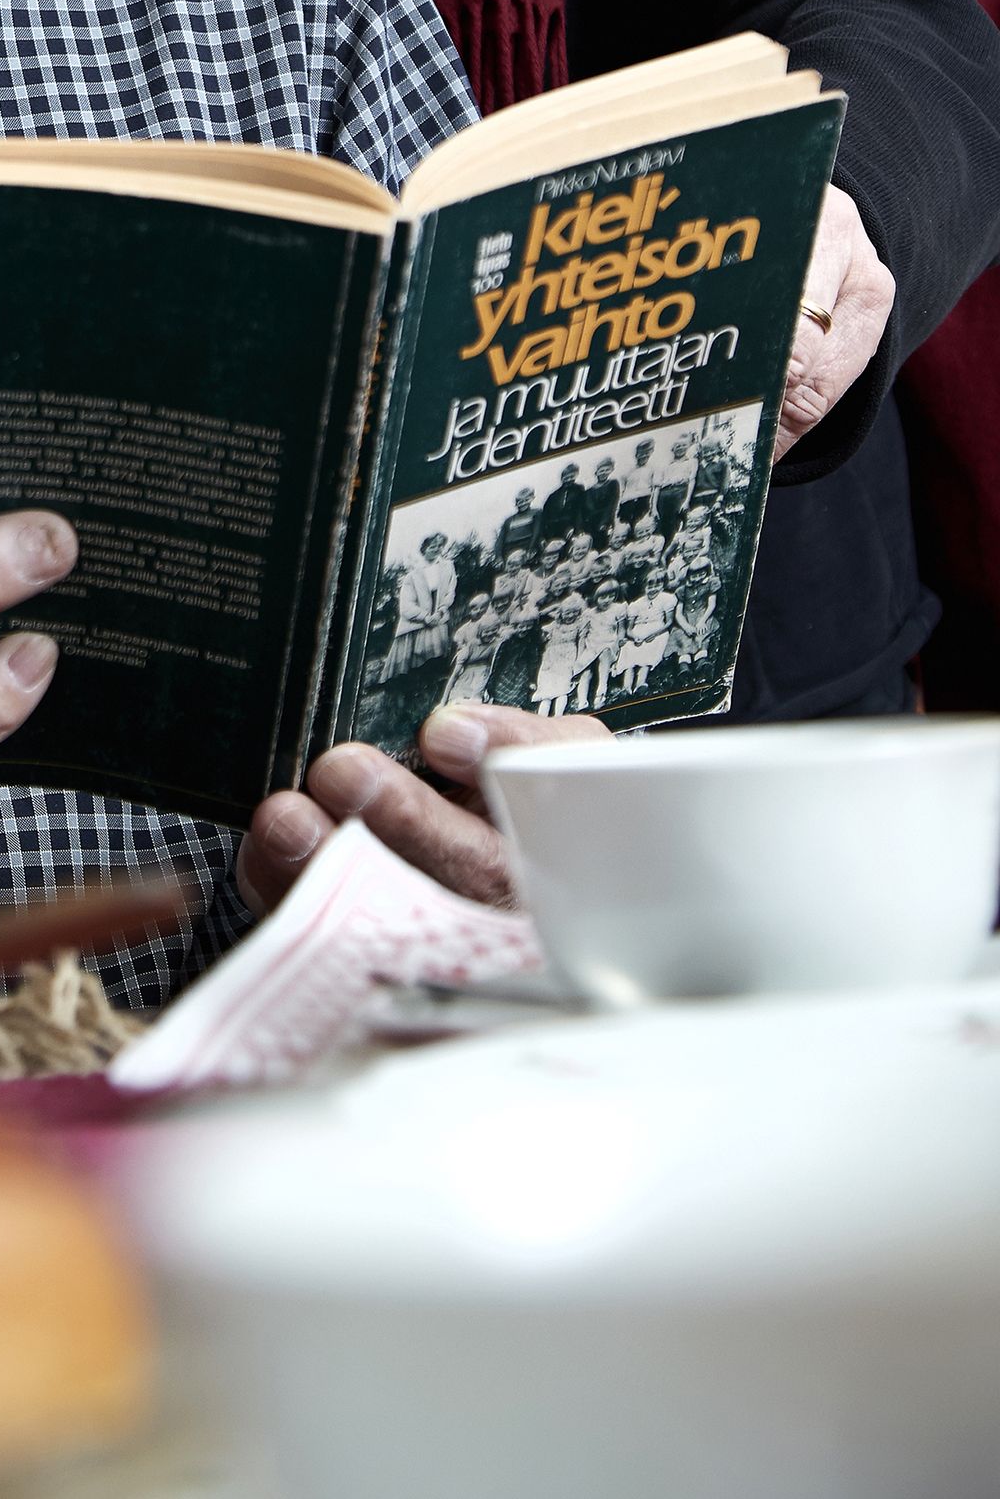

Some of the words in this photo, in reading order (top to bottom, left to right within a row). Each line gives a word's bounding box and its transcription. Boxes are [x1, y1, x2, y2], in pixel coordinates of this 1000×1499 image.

[524, 172, 681, 265] kieli-
[540, 169, 597, 203] Pirkko
[459, 216, 761, 360] yhteisön
[486, 290, 697, 386] vaihto
[426, 398, 488, 462] ja
[499, 324, 741, 420] muuttajan
[444, 376, 689, 485] identiteetti
[10, 618, 86, 635] Pielaveden
